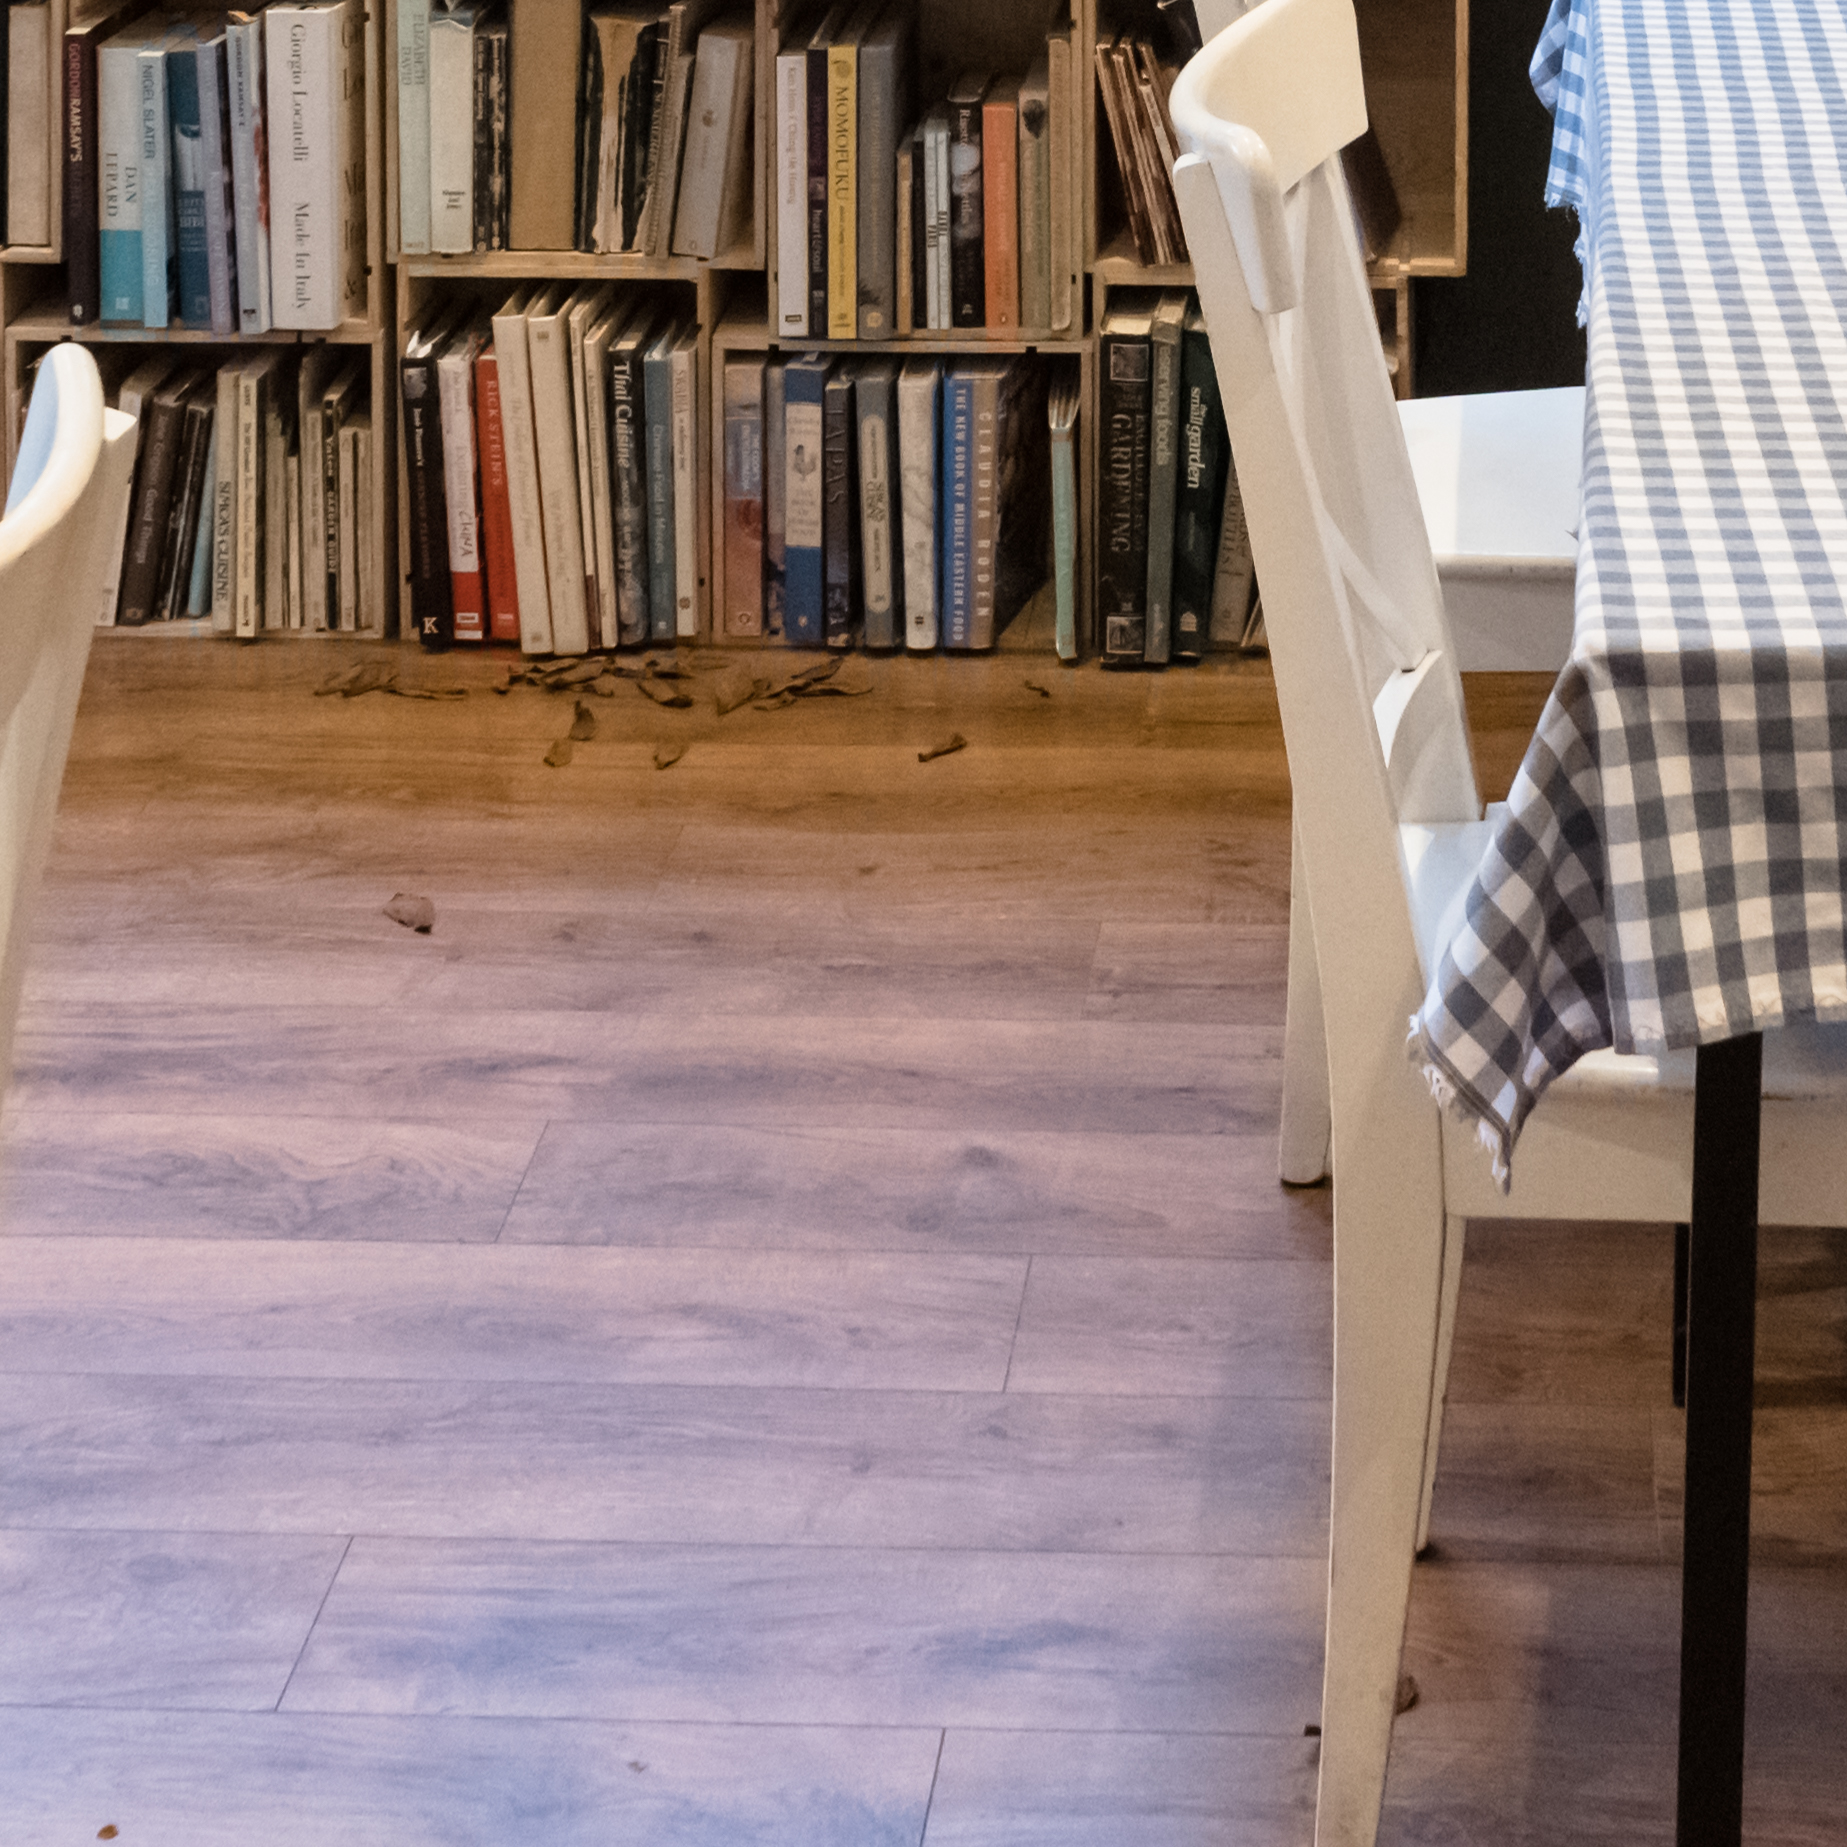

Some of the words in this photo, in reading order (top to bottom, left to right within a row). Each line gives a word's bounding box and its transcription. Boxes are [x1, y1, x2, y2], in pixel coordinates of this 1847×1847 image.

[234, 37, 243, 79] GORDON
[288, 23, 307, 85] Giorgio
[401, 46, 412, 86] DAVID
[412, 14, 425, 86] ELIZABETH
[142, 64, 155, 104] NIGEL
[142, 109, 156, 159] SLATER
[292, 90, 309, 162] Locatelli
[834, 85, 849, 201] MOMOFUKU
[105, 152, 119, 217] LEPARD
[124, 166, 138, 204] DAN
[294, 202, 311, 247] Made
[295, 251, 311, 269] In
[291, 274, 312, 311] Italy
[486, 379, 500, 418] RICK
[614, 361, 631, 401] Thai
[953, 388, 966, 410] THE
[953, 415, 966, 441] NEW
[1189, 386, 1204, 425] small
[488, 422, 504, 486] STEIN'S
[616, 404, 635, 468] Cuisine
[652, 424, 665, 472] Chinese
[827, 409, 845, 504] TAPAS
[1156, 419, 1172, 466] foods
[1185, 423, 1206, 489] garden
[456, 445, 476, 509] Exploring
[953, 446, 966, 478] BOOK
[977, 412, 991, 519] CLAUDIA
[1110, 413, 1133, 552] GARDENING
[143, 489, 158, 521] Good
[218, 482, 232, 537] SIMCA'S
[654, 473, 665, 502] Food
[654, 504, 665, 515] in
[953, 483, 966, 497] OF
[326, 491, 336, 534] GARDEN
[457, 511, 475, 558] CHINA
[953, 502, 966, 547] MIDDLE
[136, 526, 154, 564] Things
[419, 521, 431, 579] FLAVOURS
[654, 517, 666, 564] Minutes
[216, 539, 232, 602] CUISINE
[953, 552, 966, 605] EASTERN
[976, 539, 990, 617] RODEN
[423, 616, 438, 634] K
[953, 610, 966, 642] FOOD
